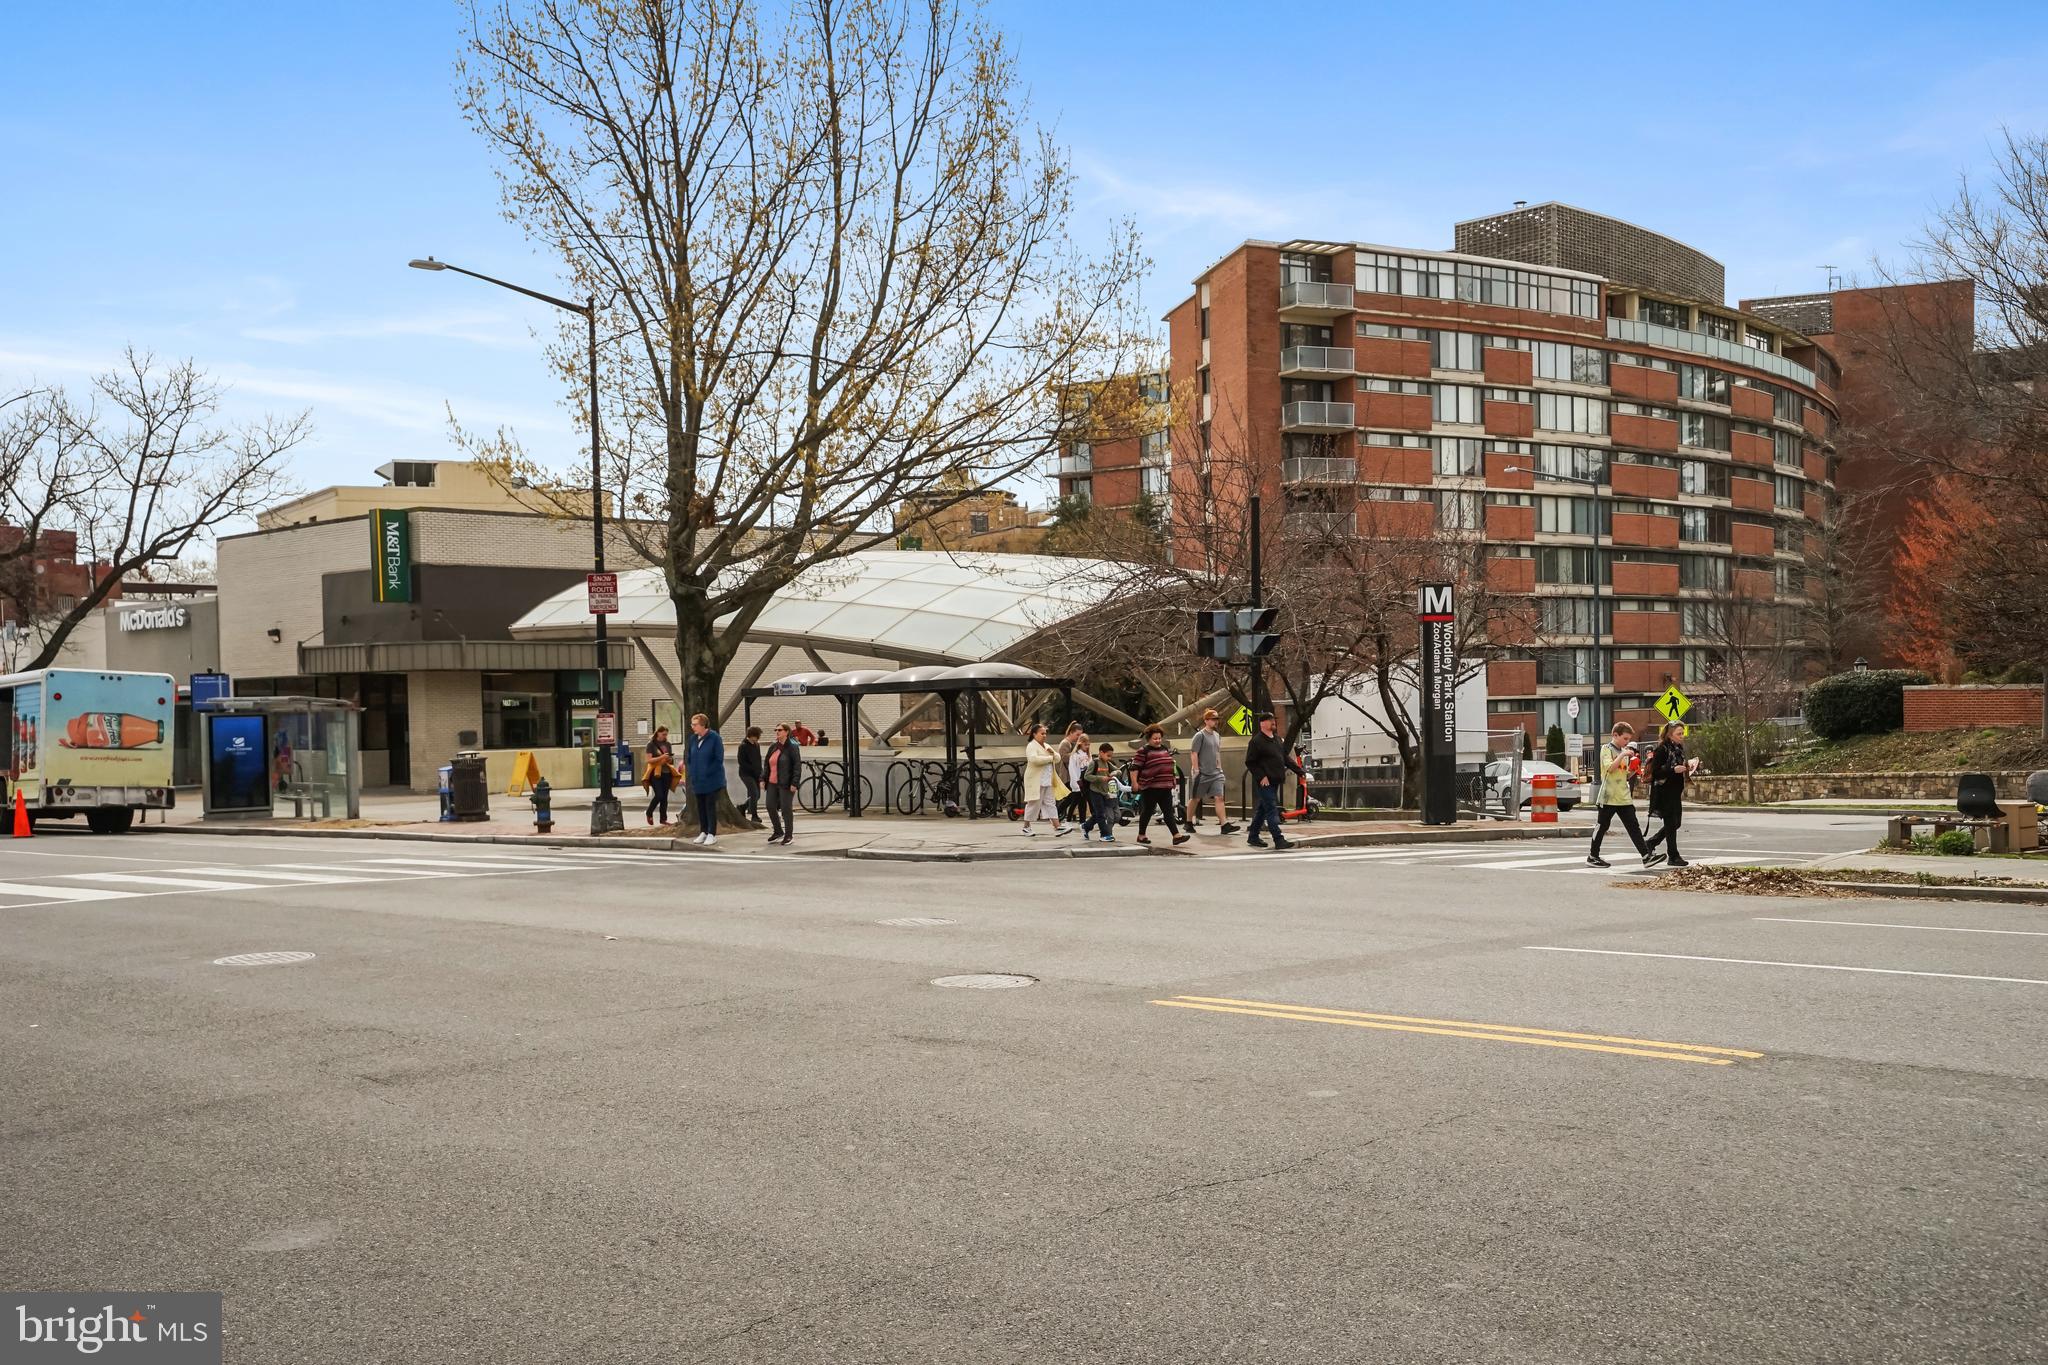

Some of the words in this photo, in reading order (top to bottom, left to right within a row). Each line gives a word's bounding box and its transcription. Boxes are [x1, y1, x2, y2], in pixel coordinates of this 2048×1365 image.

[386, 522, 400, 556] M&T
[387, 556, 401, 590] Bank
[1425, 586, 1453, 614] M
[120, 606, 186, 632] McDonald's
[1433, 622, 1442, 674] Zoo/Adams
[1442, 622, 1454, 672] Woodley
[571, 698, 586, 706] M&T
[1432, 676, 1442, 710] Morgan
[1443, 673, 1455, 699] Park
[1444, 701, 1455, 742] Station
